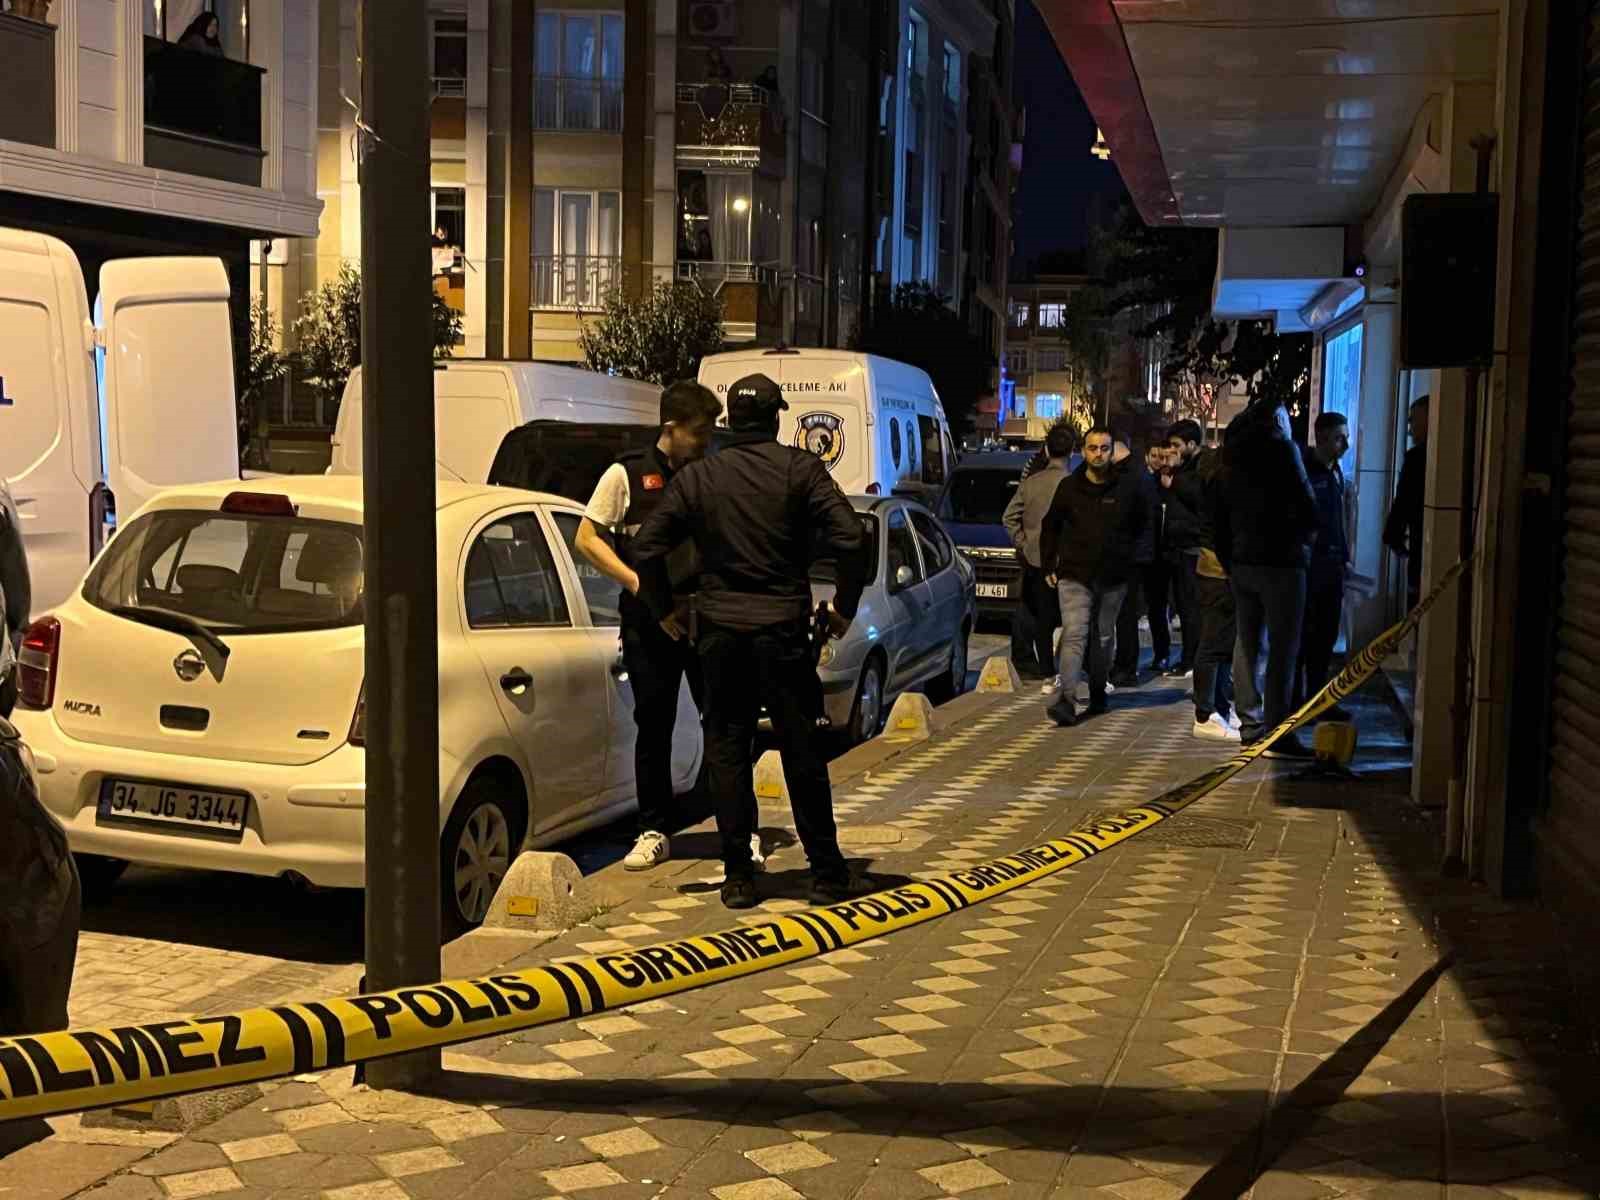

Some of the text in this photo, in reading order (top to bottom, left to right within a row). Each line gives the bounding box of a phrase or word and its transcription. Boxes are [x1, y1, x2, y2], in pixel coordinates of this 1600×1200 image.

[780, 382, 821, 392] CELEME
[63, 699, 102, 717] MICRA
[112, 785, 239, 826] 34 JG 3344
[0, 1015, 267, 1100] İLMEZ
[346, 974, 541, 1040] POLİS
[596, 922, 803, 989] GİRİLMEZ
